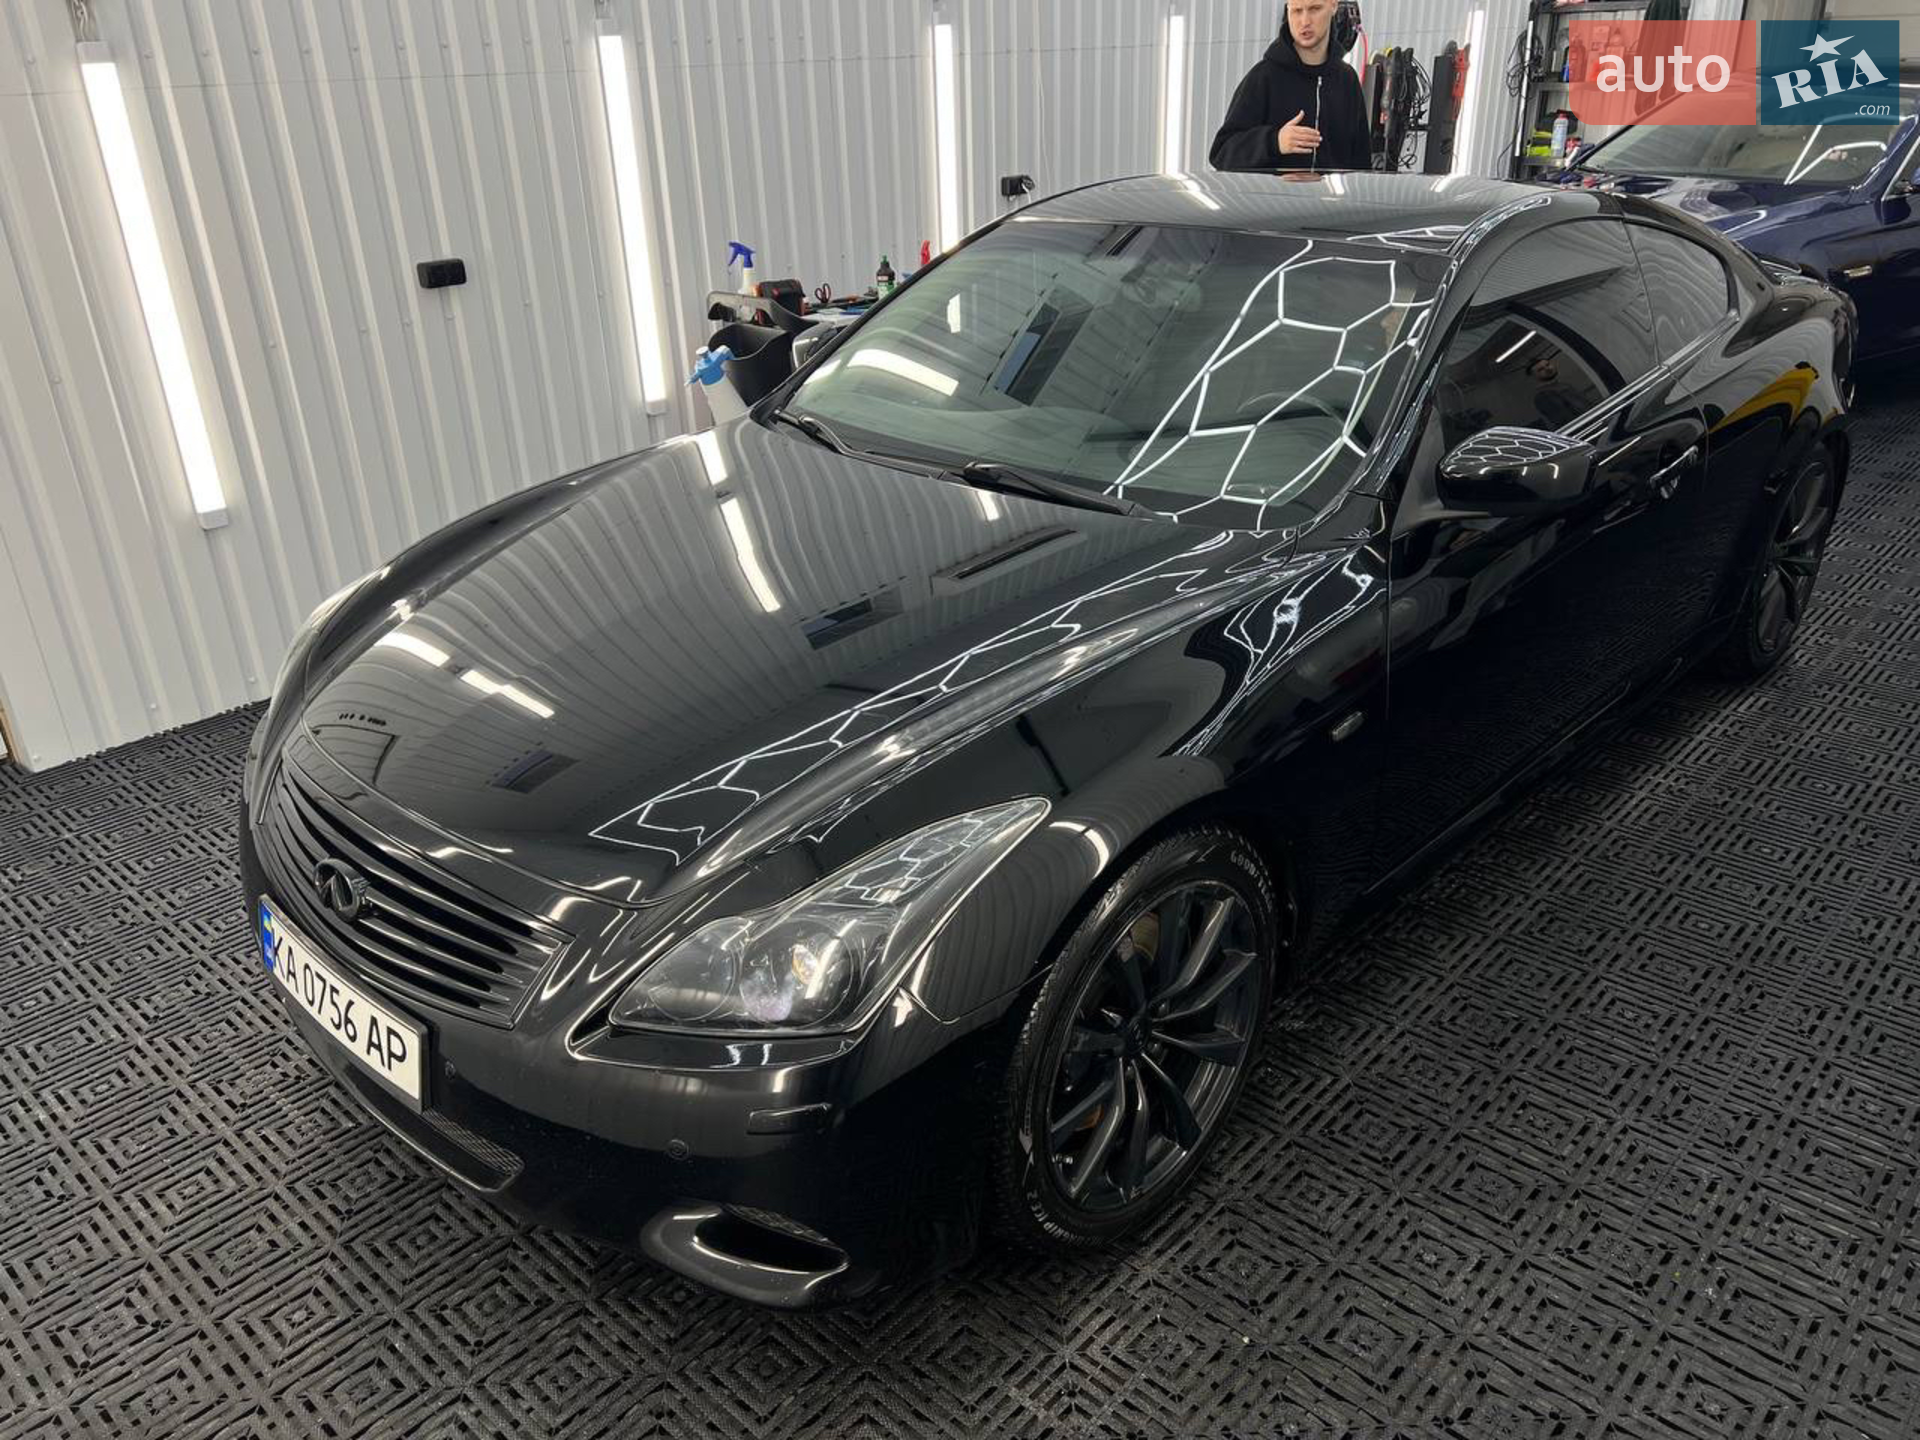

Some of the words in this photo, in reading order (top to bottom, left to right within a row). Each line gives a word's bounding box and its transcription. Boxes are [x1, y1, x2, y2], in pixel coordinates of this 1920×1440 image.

[1230, 850, 1272, 914] GOOD
[271, 926, 299, 995] KA
[303, 962, 358, 1044] 0756
[366, 1014, 407, 1072] AP
